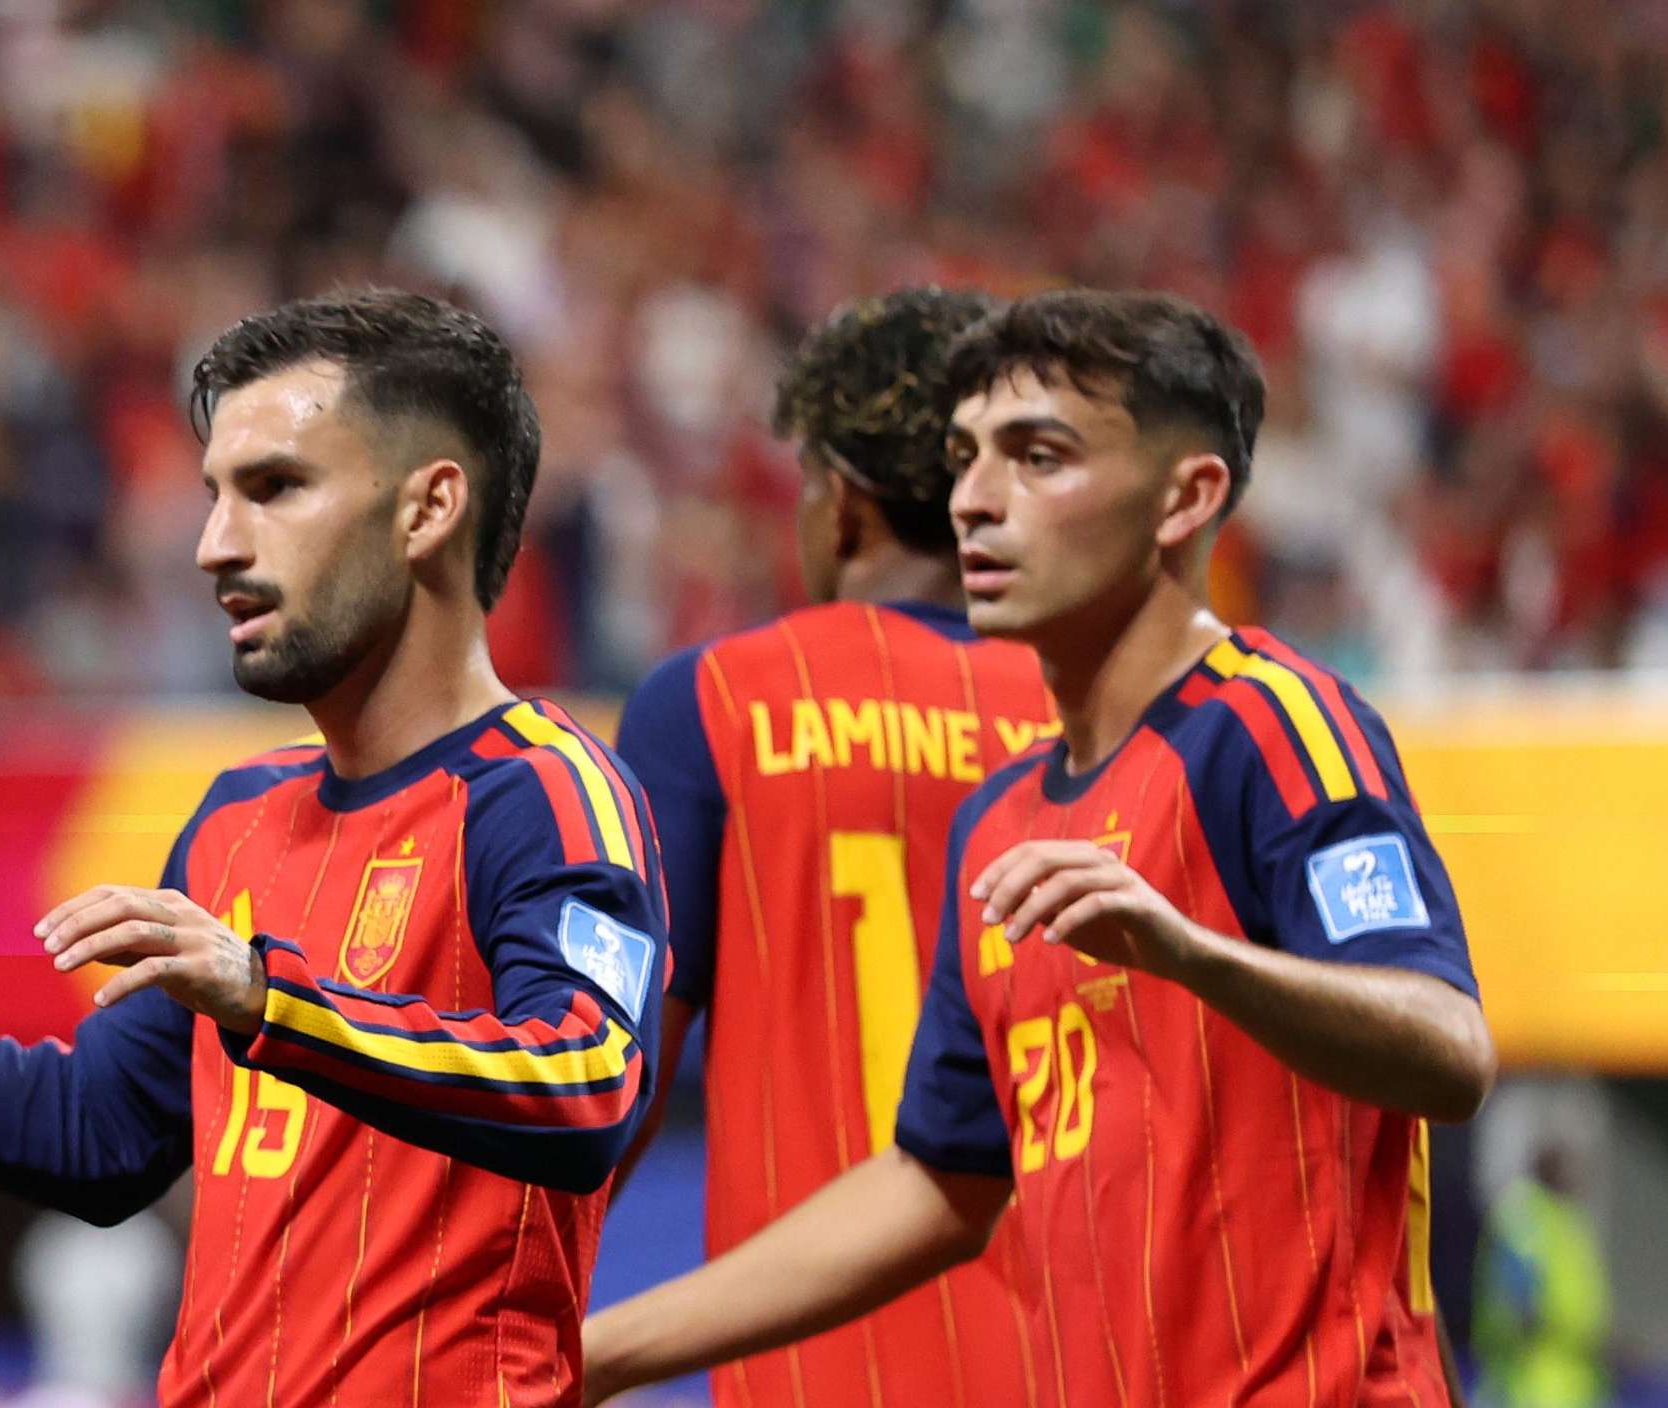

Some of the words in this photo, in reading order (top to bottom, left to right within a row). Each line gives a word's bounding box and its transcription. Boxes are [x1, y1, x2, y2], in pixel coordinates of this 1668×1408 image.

[750, 698, 984, 783] LAMINE
[831, 832, 921, 1158] 1
[212, 1066, 308, 1178] 15
[1008, 1002, 1098, 1174] 20
